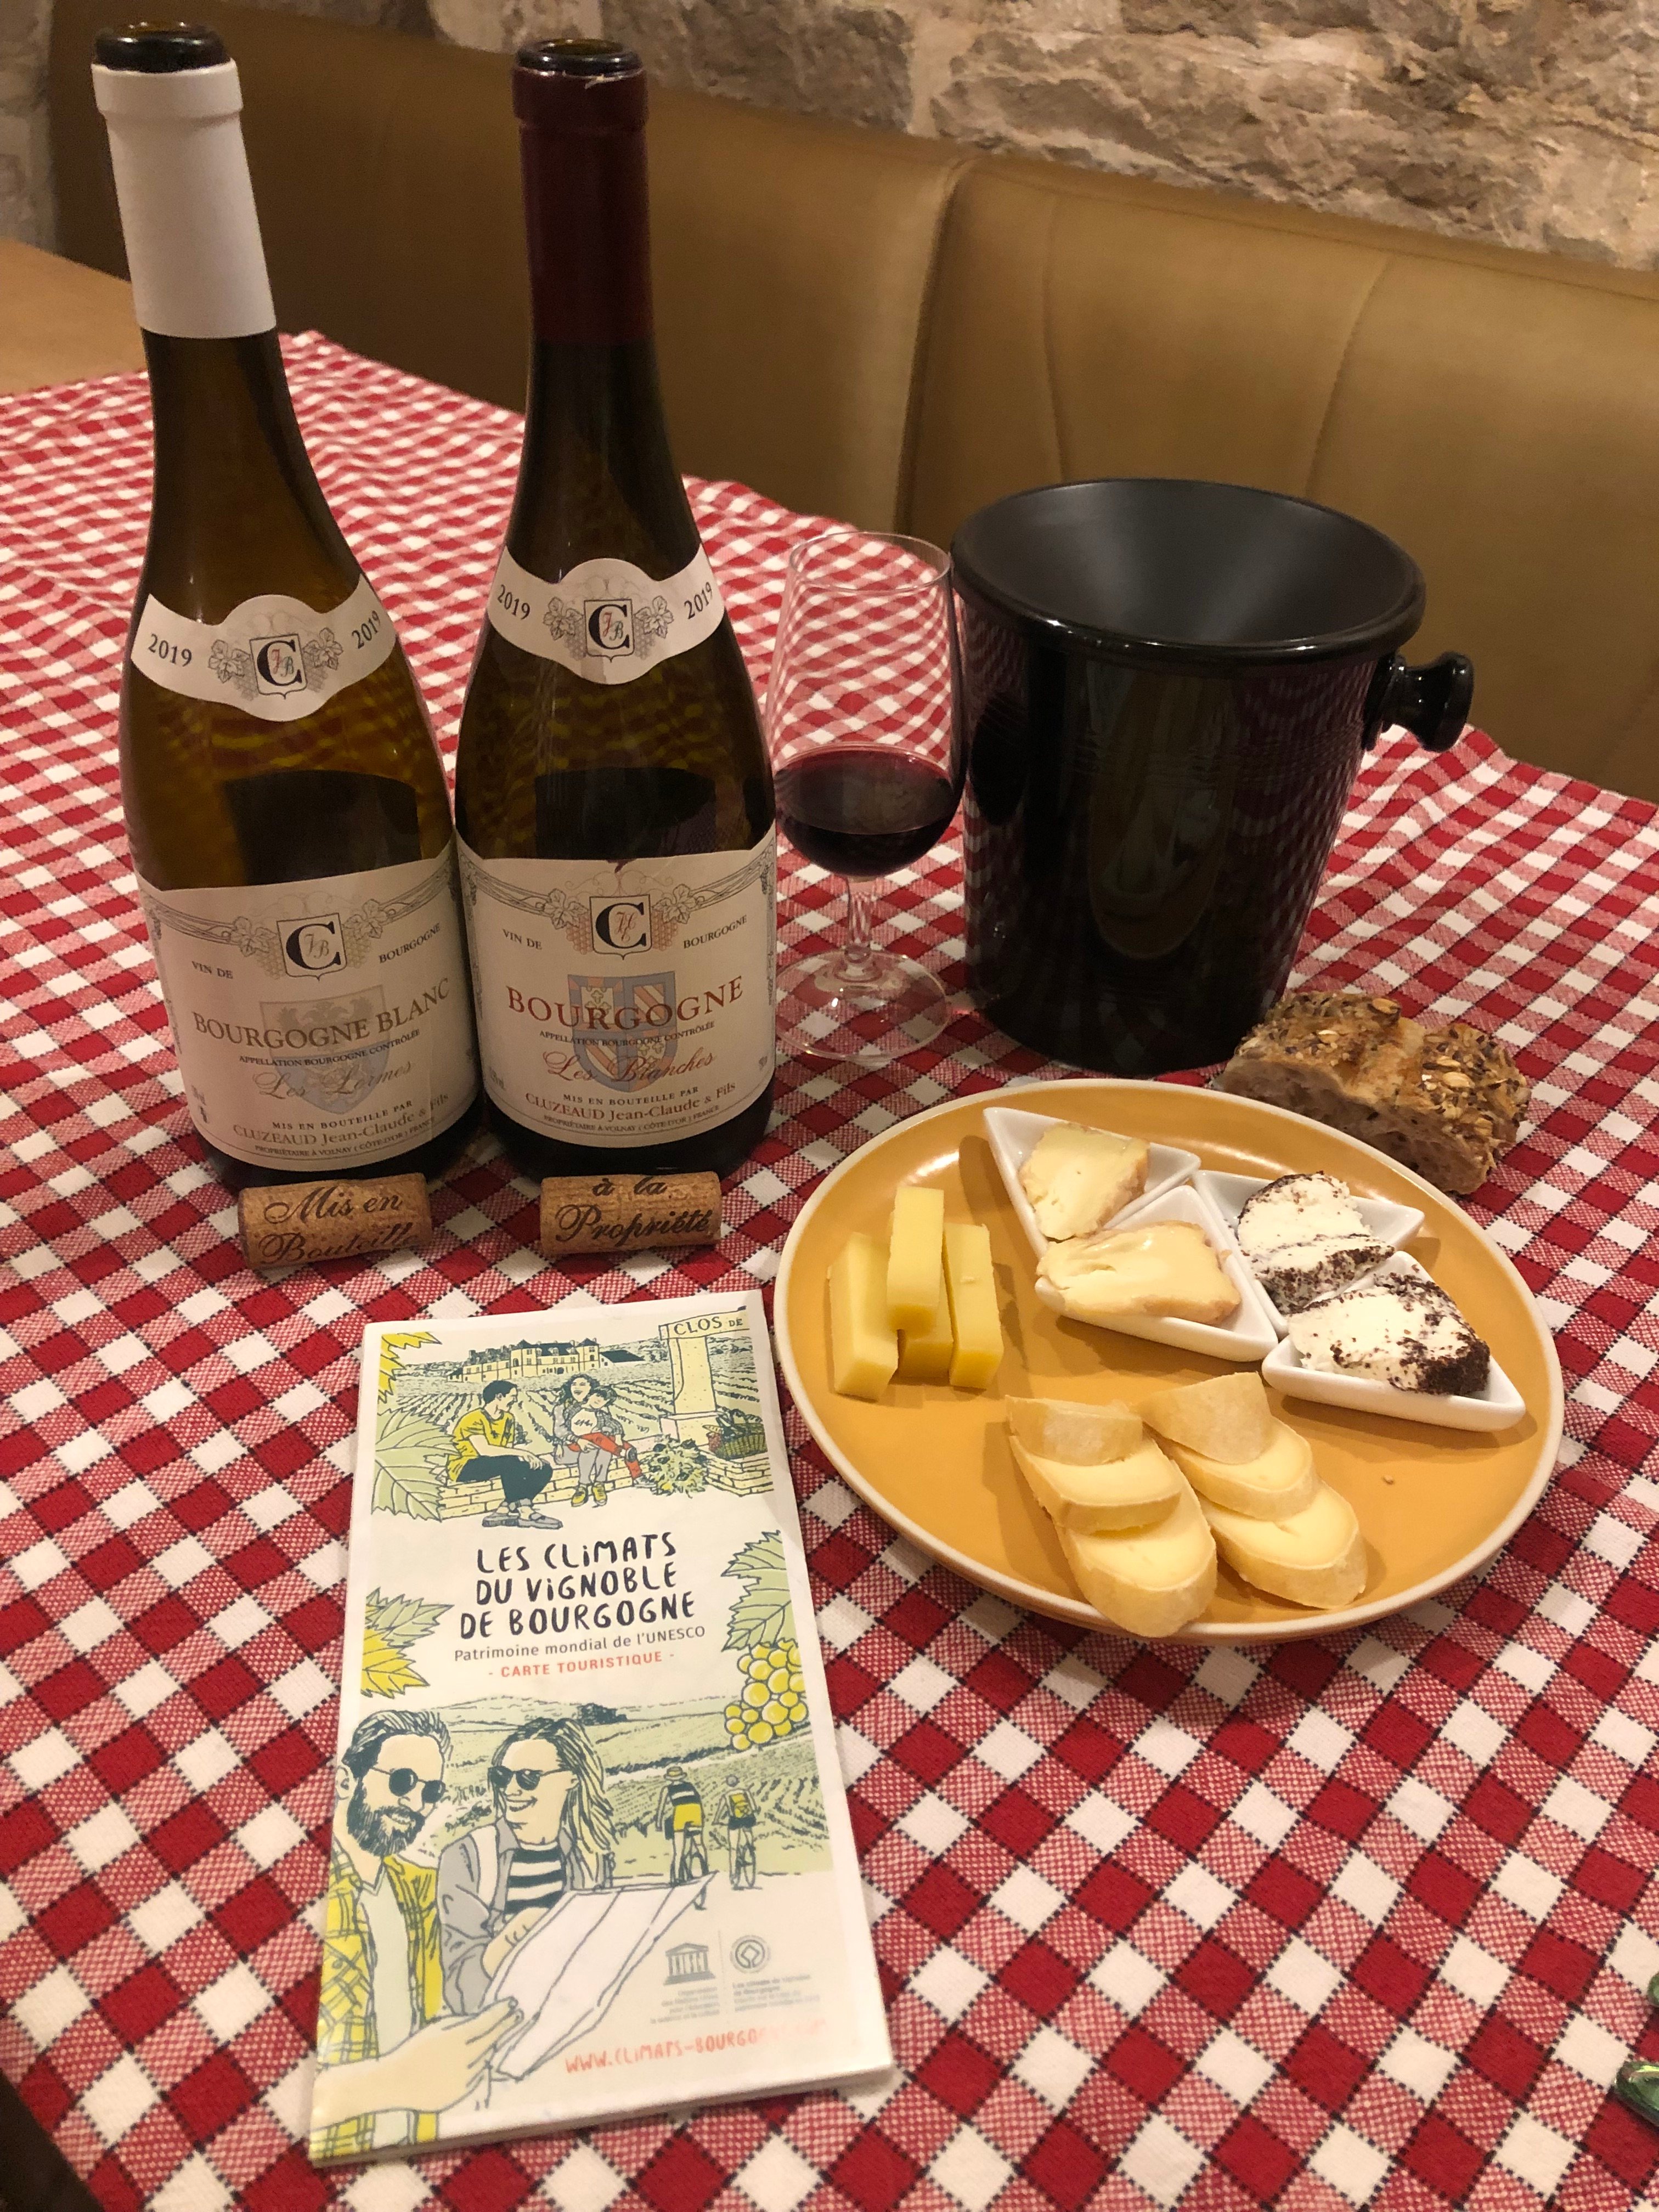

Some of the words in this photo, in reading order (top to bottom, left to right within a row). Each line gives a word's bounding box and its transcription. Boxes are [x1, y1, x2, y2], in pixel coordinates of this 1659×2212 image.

[497, 584, 531, 621] 2019
[683, 582, 714, 620] 2019
[351, 610, 381, 649] 2019
[147, 633, 192, 668] 2019
[379, 923, 441, 963] BOURGOGNE
[502, 929, 522, 944] VIN
[527, 938, 542, 950] DE
[683, 915, 748, 949] BOURGOGNE
[191, 961, 212, 975] VIN
[217, 966, 233, 979] DE
[192, 1012, 370, 1049] BOURGOGNE
[376, 978, 449, 1032] BLANC
[506, 975, 744, 1031] BOURGOGNE
[239, 1056, 302, 1066] APPELLATION
[304, 1051, 368, 1066] BOURGOGNE
[369, 1029, 420, 1054] CONTRÔLÉE
[539, 1030, 599, 1046] APPELLATION
[601, 1036, 662, 1047] BOURGOGNE
[664, 1020, 715, 1042] CONTRÔLÉE
[543, 1051, 597, 1081] Les
[611, 1046, 714, 1082] Blanches
[253, 1071, 306, 1099] Les
[526, 1092, 605, 1120] CLUZEAUD
[608, 1096, 701, 1122] Jean-Claude
[716, 1082, 736, 1099] Fils
[563, 1093, 583, 1103] MIS
[589, 1097, 603, 1105] EN
[609, 1093, 675, 1105] BOUTEILLE
[680, 1086, 698, 1096] PAR
[233, 1124, 317, 1145] CLUZEAUD
[321, 1113, 414, 1147] Jean-Claude
[430, 1094, 449, 1111] Fils
[272, 1122, 292, 1130] MIS
[320, 1109, 388, 1129] BOUTEILLE
[393, 1100, 413, 1113] PAR
[592, 1177, 616, 1196] à
[634, 1176, 667, 1195] la
[264, 1186, 354, 1223] Mis
[363, 1194, 404, 1212] en
[554, 1204, 713, 1247] Propriété
[674, 1317, 723, 1335] CLOS
[729, 1318, 743, 1327] DE
[476, 1546, 529, 1573] LES
[476, 1578, 512, 1606] DU
[460, 1610, 493, 1640] DE
[509, 1590, 695, 1637] BOURGOGNE
[454, 1645, 539, 1662] Patrimoine
[545, 1638, 607, 1657] mondial
[613, 1635, 631, 1648] de
[637, 1625, 706, 1645] l'UNESCO
[500, 1663, 550, 1678] CARTE
[558, 1651, 663, 1674] TOURISTIQUE
